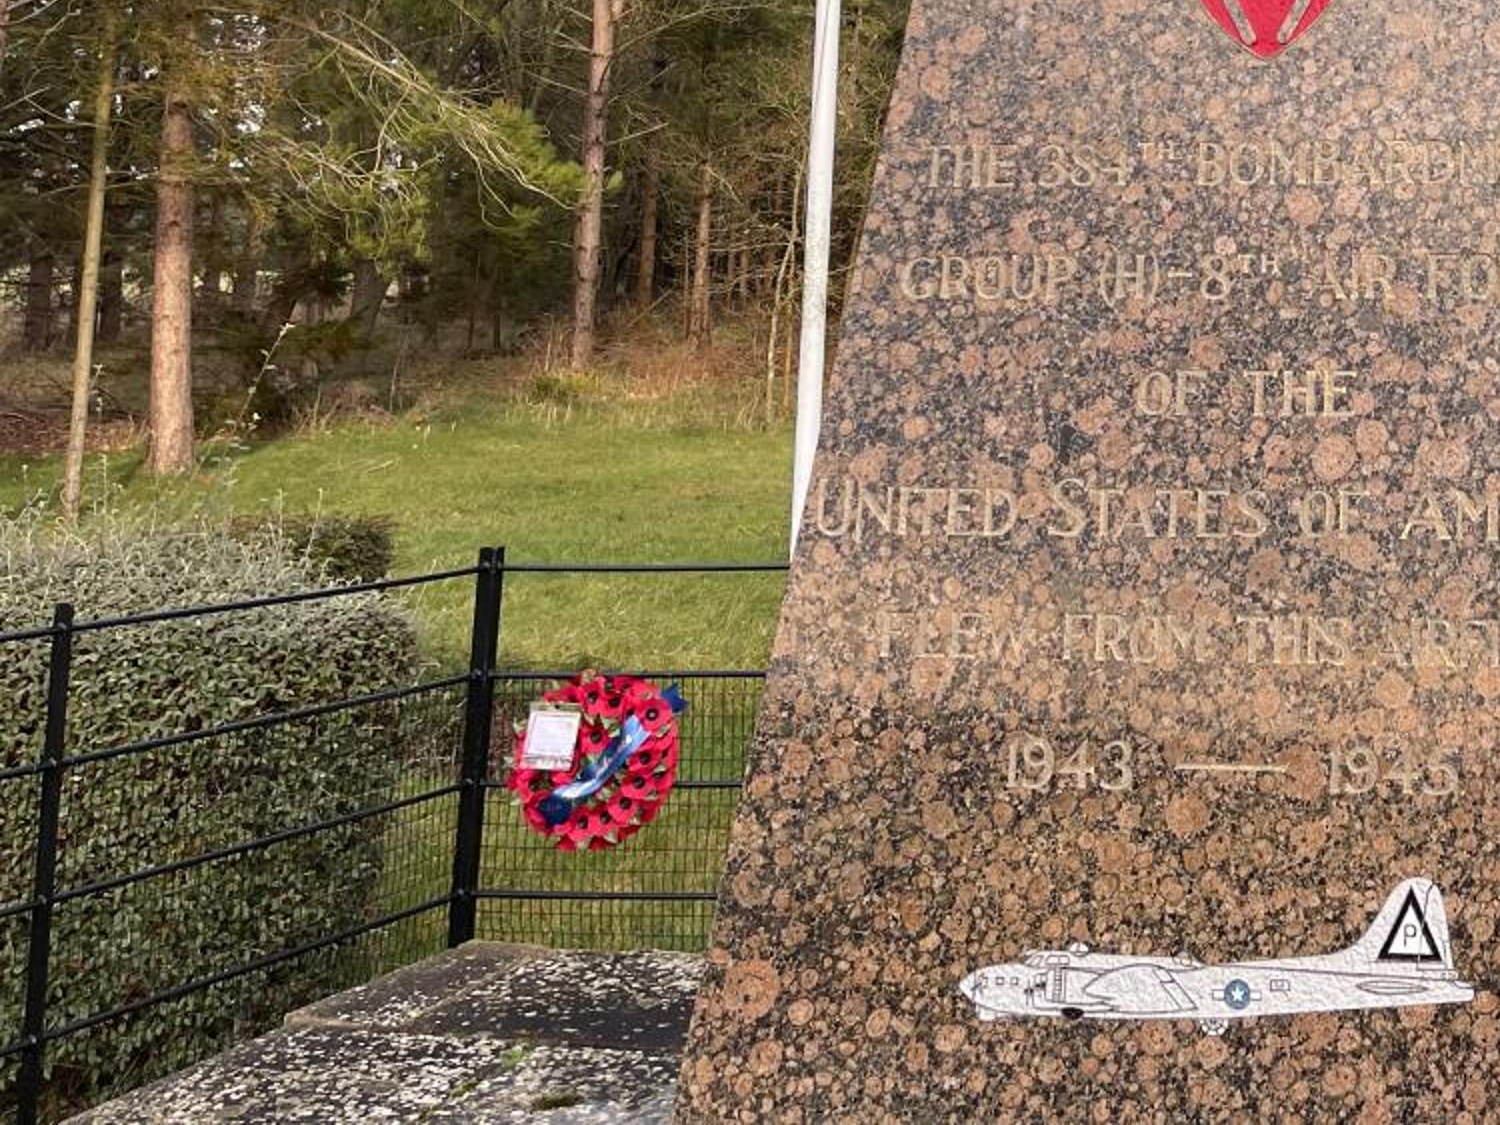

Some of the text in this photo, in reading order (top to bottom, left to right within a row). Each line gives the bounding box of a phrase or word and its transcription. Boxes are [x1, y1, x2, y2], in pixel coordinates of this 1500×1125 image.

[927, 143, 1018, 188] THE
[902, 254, 1076, 301] GROUP
[1304, 253, 1398, 302] AIR
[1135, 369, 1358, 417] OF THE
[816, 479, 1018, 543] UNITED
[1047, 478, 1268, 539] STATES
[1297, 490, 1370, 540] OF
[874, 612, 1032, 661] FLEW
[1061, 613, 1206, 663] FROM
[1236, 615, 1348, 666] THIS
[1006, 734, 1134, 791] 1943
[1327, 746, 1460, 796] 1945
